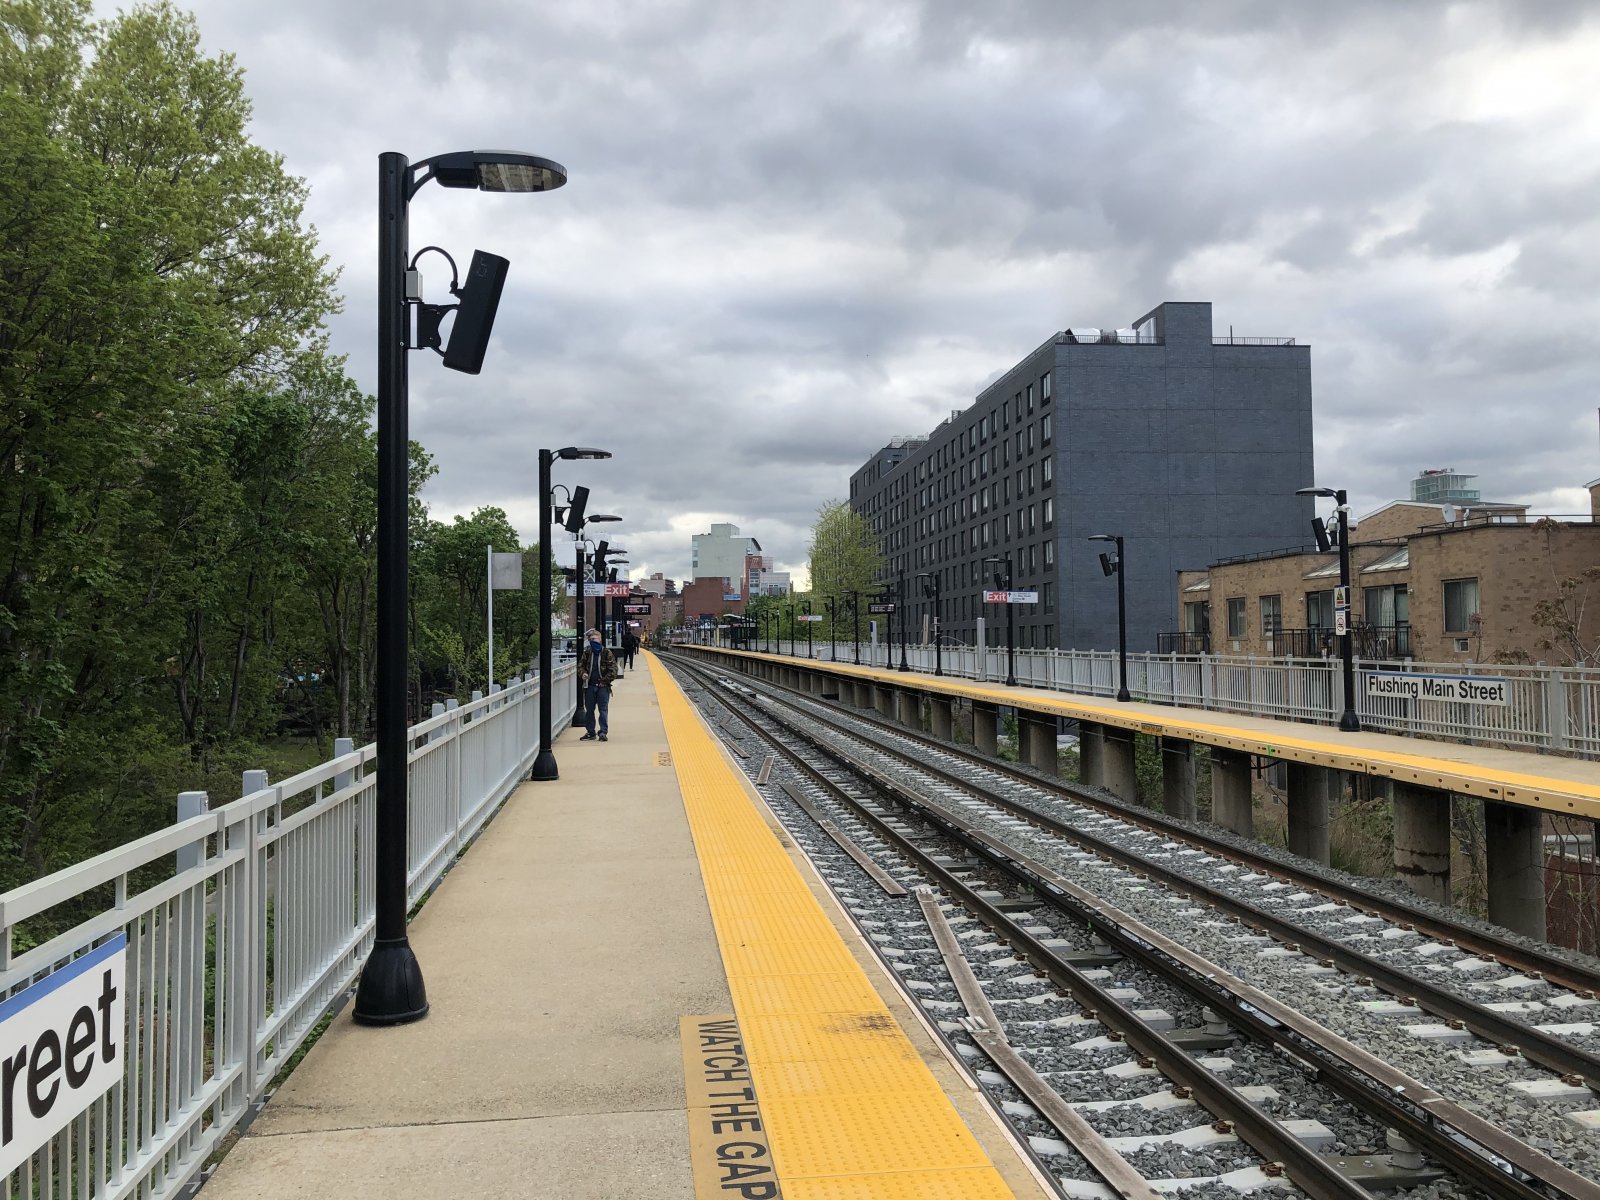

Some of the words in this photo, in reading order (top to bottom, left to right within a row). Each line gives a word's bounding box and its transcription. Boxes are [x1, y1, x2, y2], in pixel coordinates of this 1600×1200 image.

[605, 584, 628, 595] Exit
[987, 592, 1006, 601] Exit
[1369, 676, 1418, 699] Flushing
[1423, 678, 1455, 698] Main
[1459, 680, 1504, 701] Street
[2, 969, 116, 1147] reet
[698, 1020, 750, 1082] WATCH
[708, 1088, 761, 1134] THE
[716, 1142, 778, 1200] GAP
